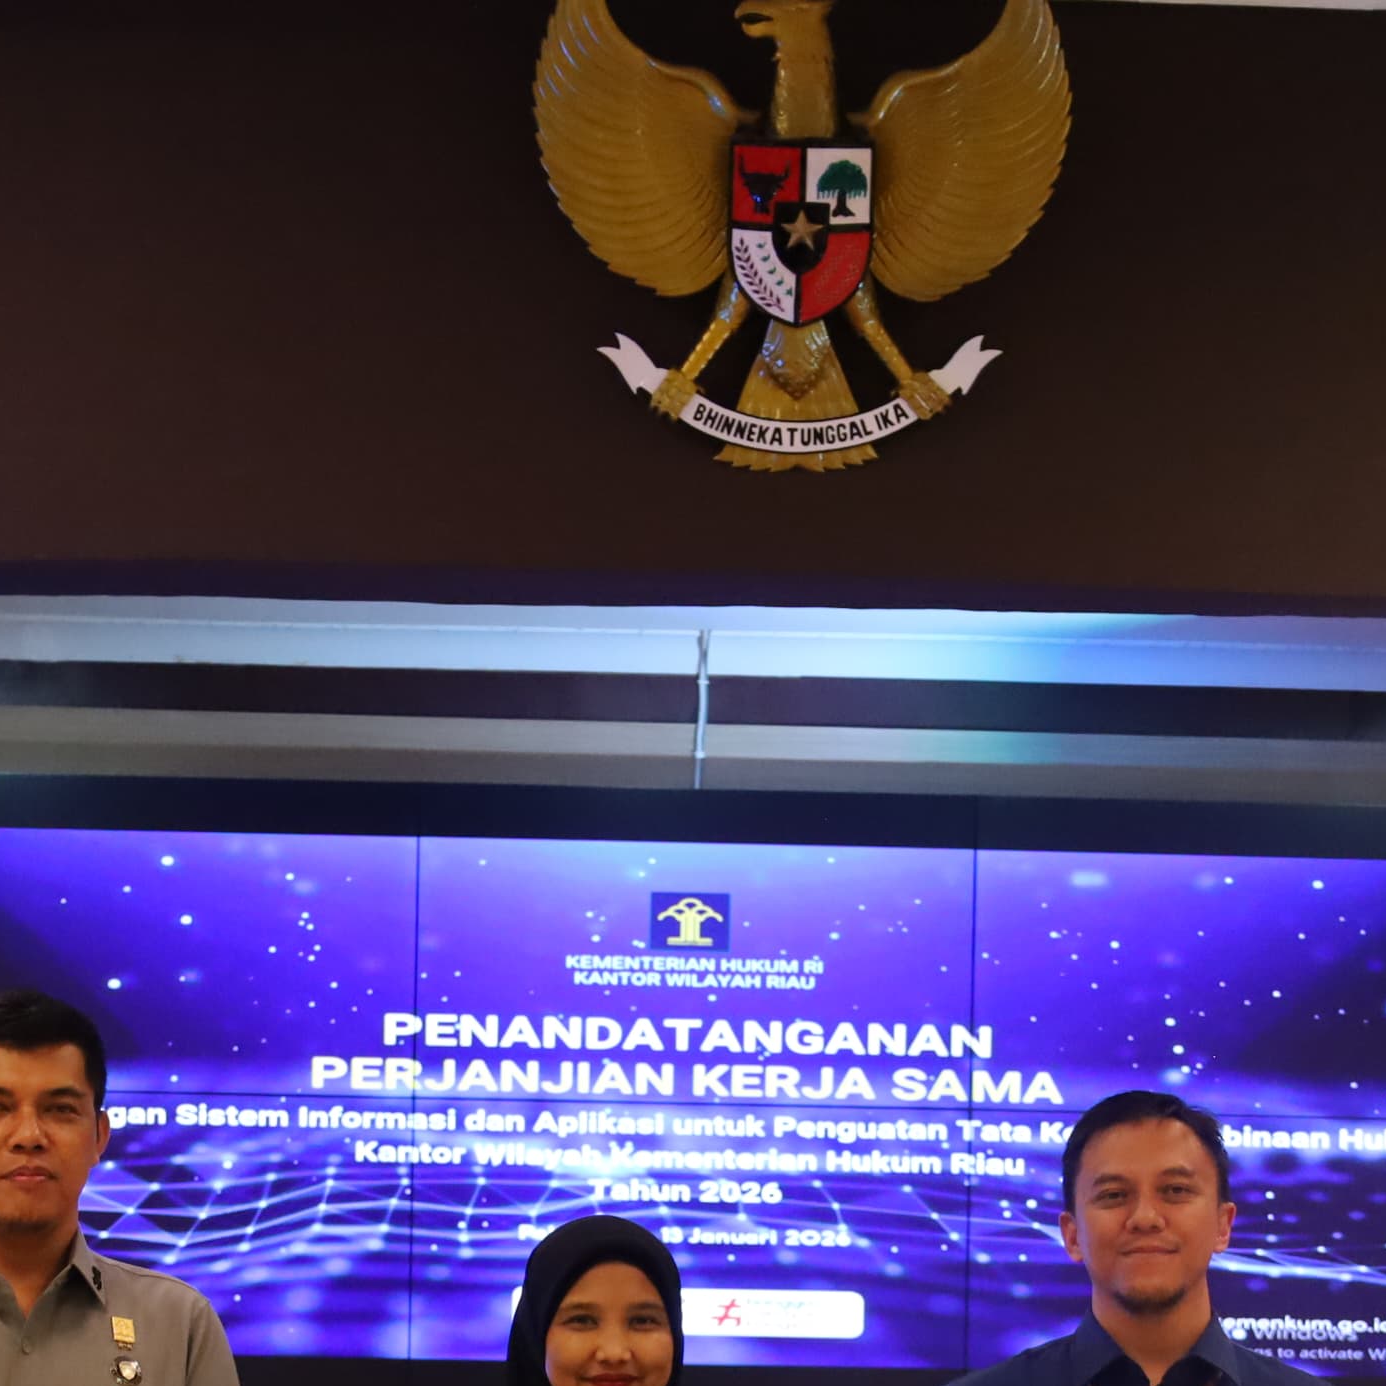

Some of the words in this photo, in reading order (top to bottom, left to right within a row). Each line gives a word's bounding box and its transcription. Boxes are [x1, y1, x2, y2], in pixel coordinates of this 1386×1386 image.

[693, 403, 783, 446] BHINNEKA
[787, 420, 873, 447] TUNGGAL
[875, 403, 909, 432] IKA
[565, 955, 716, 972] KEMENTERIAN
[720, 958, 799, 974] HUKUM
[803, 959, 824, 974] RI
[574, 971, 661, 986] KANTOR
[665, 973, 762, 988] WILAYAH
[766, 974, 816, 990] RIAU
[383, 1012, 993, 1058] PENANDATANGANAN
[311, 1055, 674, 1096] PERJANJIAN
[692, 1064, 876, 1101] KERJA
[891, 1068, 1064, 1105] SAMA
[176, 1103, 289, 1128] Sistem
[298, 1106, 457, 1131] Informasi
[464, 1109, 525, 1132] dan
[533, 1110, 665, 1137] Aplikasi
[673, 1113, 765, 1138] untuk
[774, 1115, 948, 1144] Penguatan
[955, 1119, 1031, 1143] Tata
[1222, 1124, 1330, 1150] binaan
[354, 1140, 467, 1165] Kantor
[474, 1142, 601, 1169] Wilayah
[610, 1141, 817, 1172] Kementerian
[826, 1150, 942, 1174] Hukum
[950, 1153, 1025, 1176] Riau
[587, 1178, 690, 1202] Tahun
[698, 1181, 783, 1204] 2026
[660, 1226, 683, 1244] 13
[687, 1228, 778, 1246] Januari
[784, 1229, 852, 1248] 2026
[1278, 1347, 1293, 1360] to
[1299, 1347, 1363, 1361] activate
